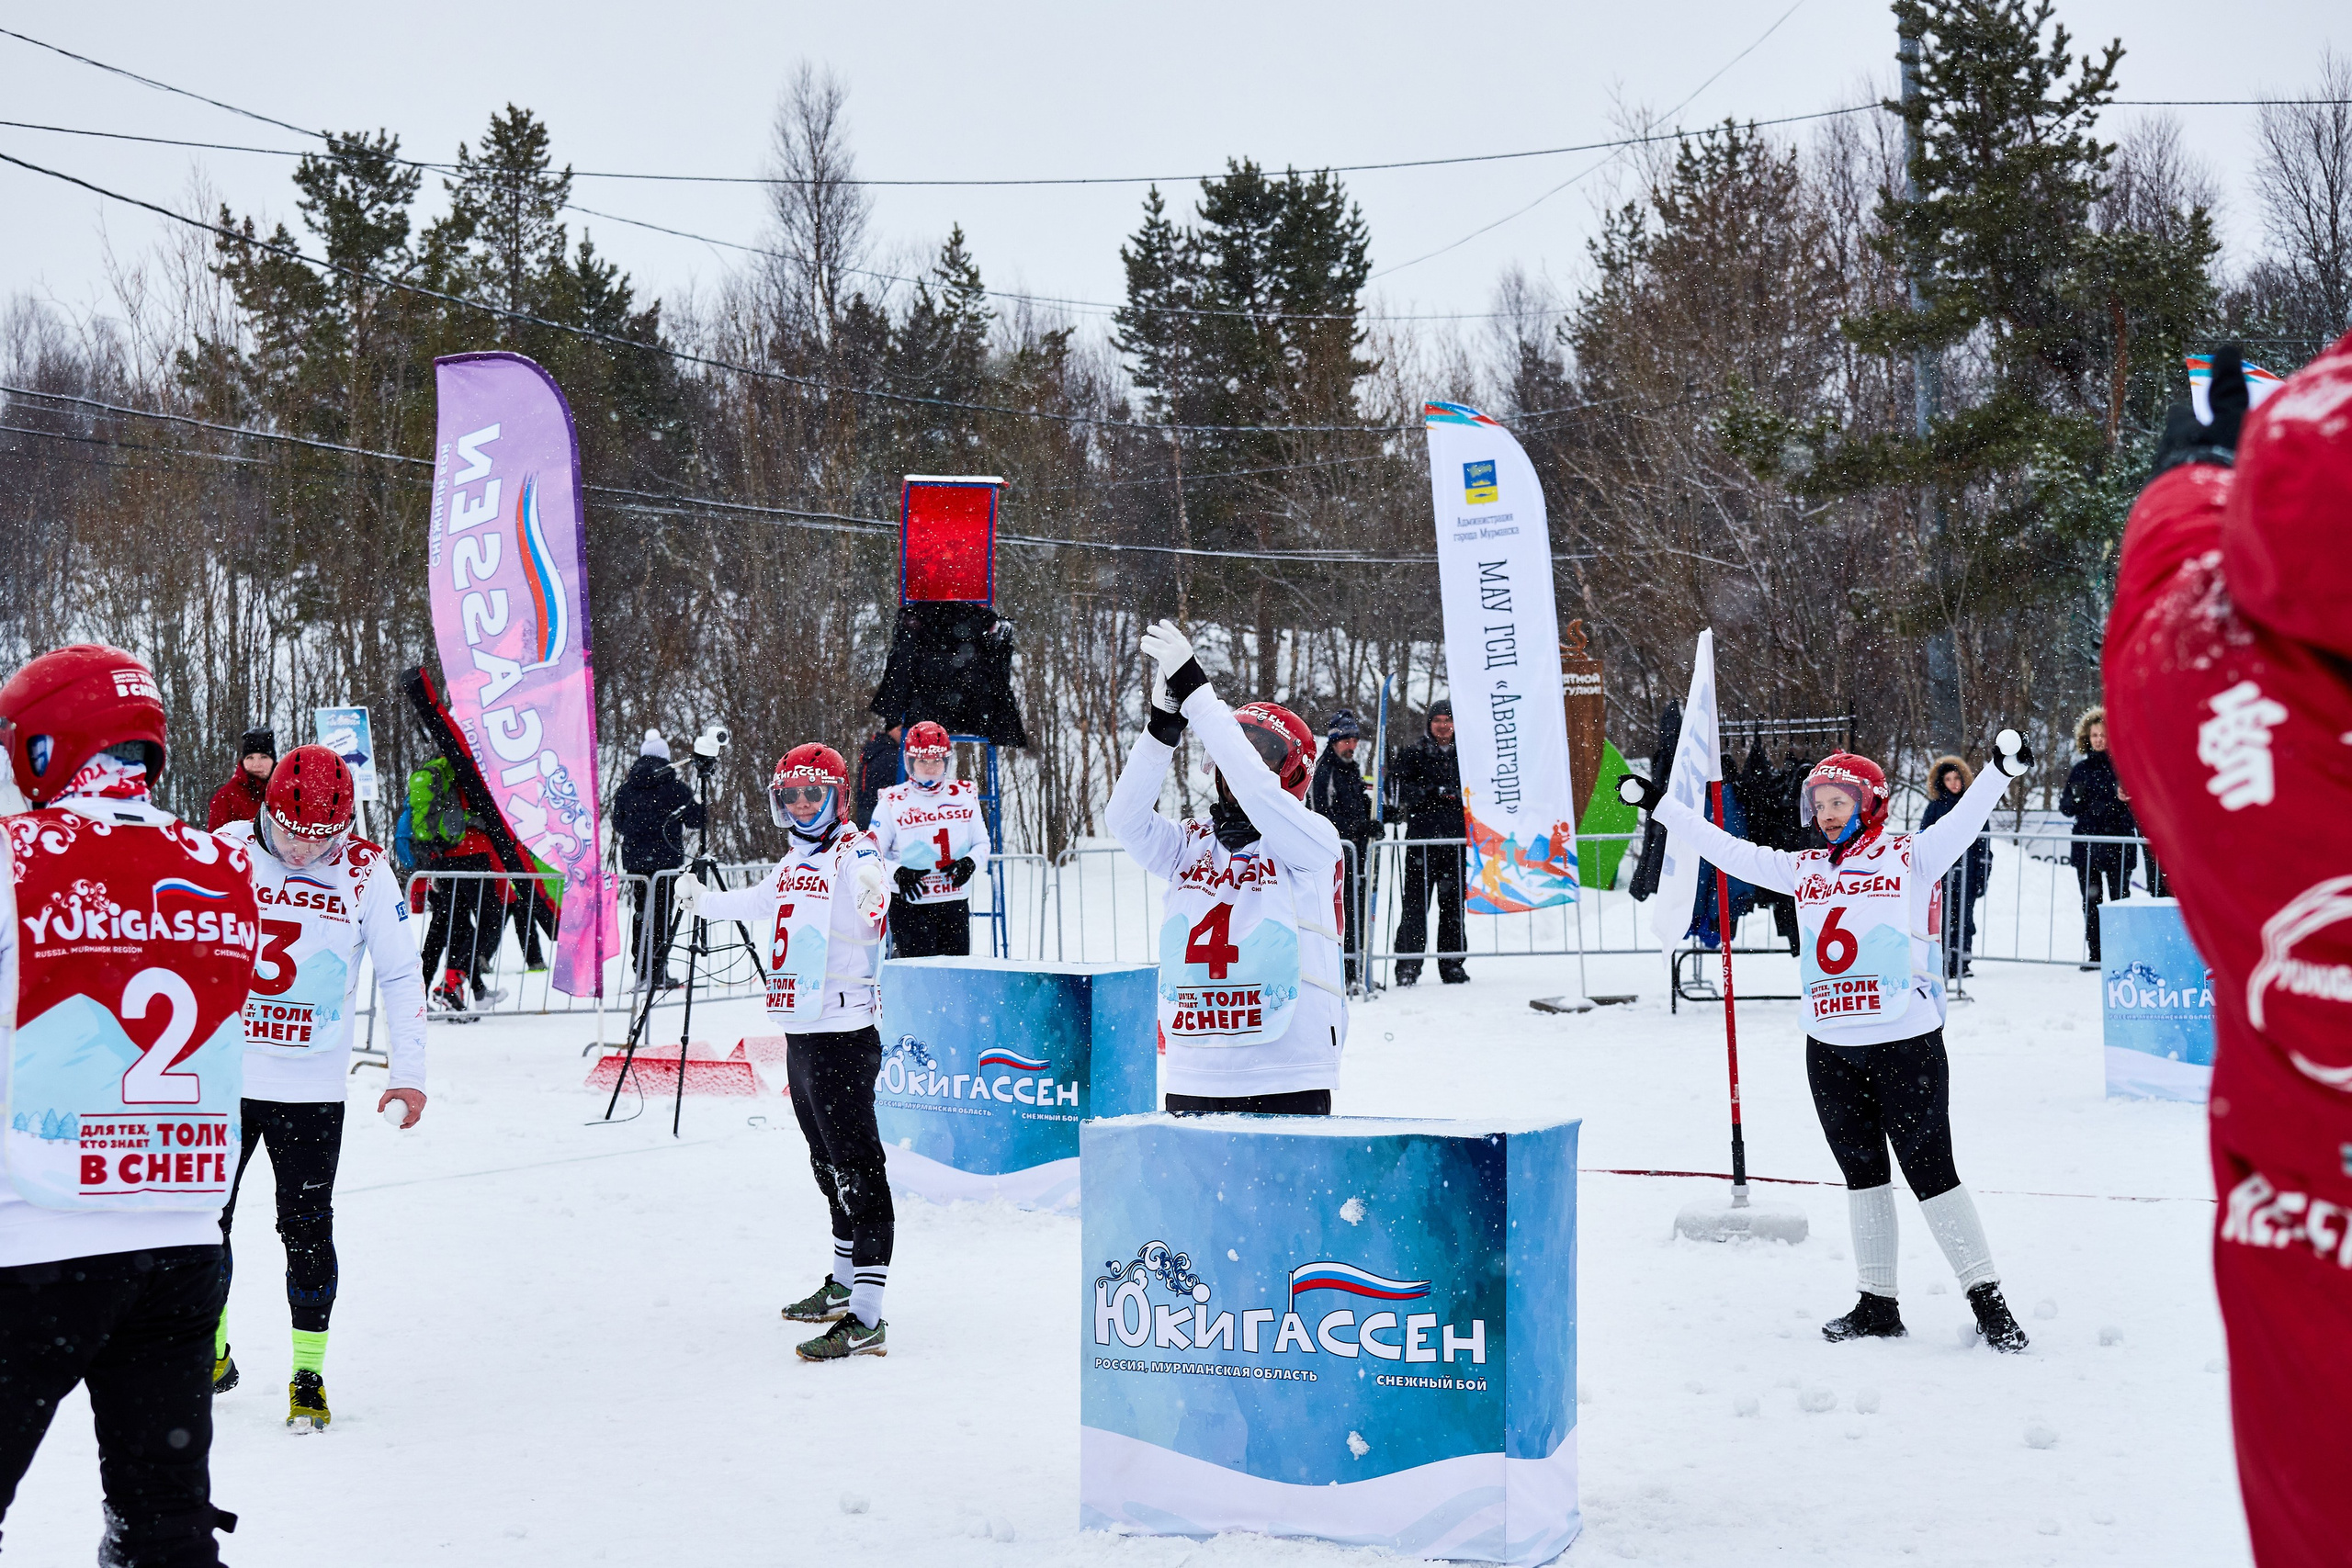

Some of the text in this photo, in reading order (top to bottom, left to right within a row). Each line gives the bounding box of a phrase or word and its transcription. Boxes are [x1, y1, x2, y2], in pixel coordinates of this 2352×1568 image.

[1477, 558, 1513, 614] МАУ
[1484, 623, 1518, 671] ГСЦ
[933, 829, 956, 869] 1
[772, 904, 795, 971] 5
[1185, 902, 1239, 979] 4
[1816, 907, 1858, 975] 6
[250, 919, 302, 996] 3
[773, 978, 796, 990] ТОЛК
[1721, 947, 1730, 995] LISKI
[1202, 990, 1261, 1007] ТОЛК
[1833, 980, 1879, 994] ТОЛК
[261, 1005, 313, 1022] ТОЛК
[1819, 995, 1881, 1015] СНЕГЕ
[121, 967, 200, 1104] 2
[958, 1108, 992, 1116] ОБЛАСТЬ
[1022, 1112, 1079, 1122] СНЕЖНЫЙ БОЙ
[81, 1123, 150, 1137] ДЛЯ ТЕХ,
[81, 1122, 227, 1148] КТО ЗНАЕТ ТОЛК
[80, 1153, 226, 1185] В СНЕГЕ
[1094, 1358, 1317, 1382] РОССИЯ, МУРМАНСКАЯ ОБЛАСТЬ
[1376, 1374, 1487, 1392] СНЕЖНЫЙ БОЙ
